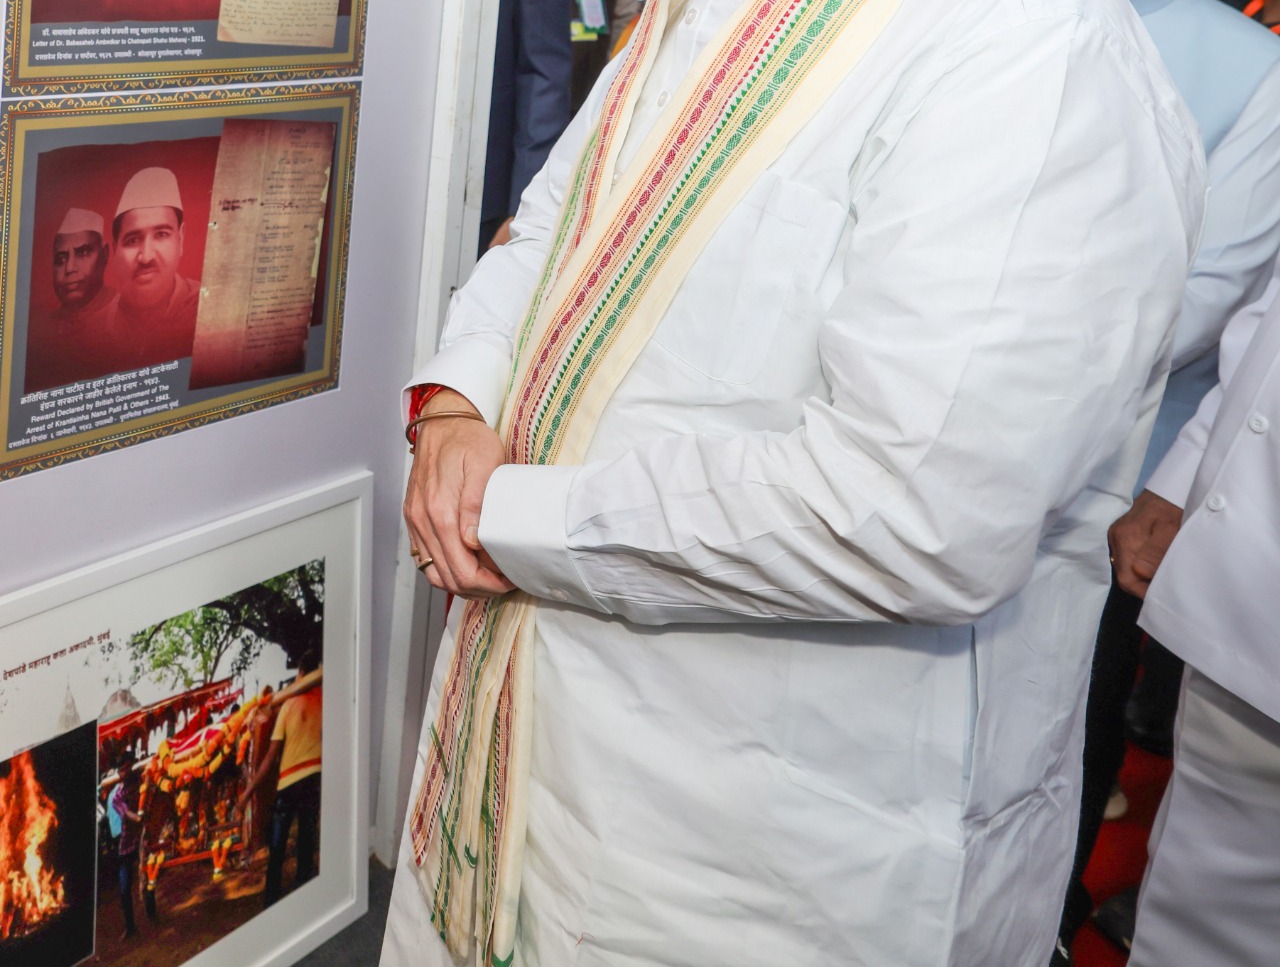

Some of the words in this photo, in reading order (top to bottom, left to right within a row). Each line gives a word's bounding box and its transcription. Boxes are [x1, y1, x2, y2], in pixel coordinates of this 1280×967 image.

[31, 411, 56, 423] Reward
[57, 404, 85, 417] Declared
[95, 398, 114, 407] British
[115, 389, 150, 403] Government
[151, 386, 157, 394] of
[25, 424, 46, 434] Arrest
[91, 410, 107, 418] Nana
